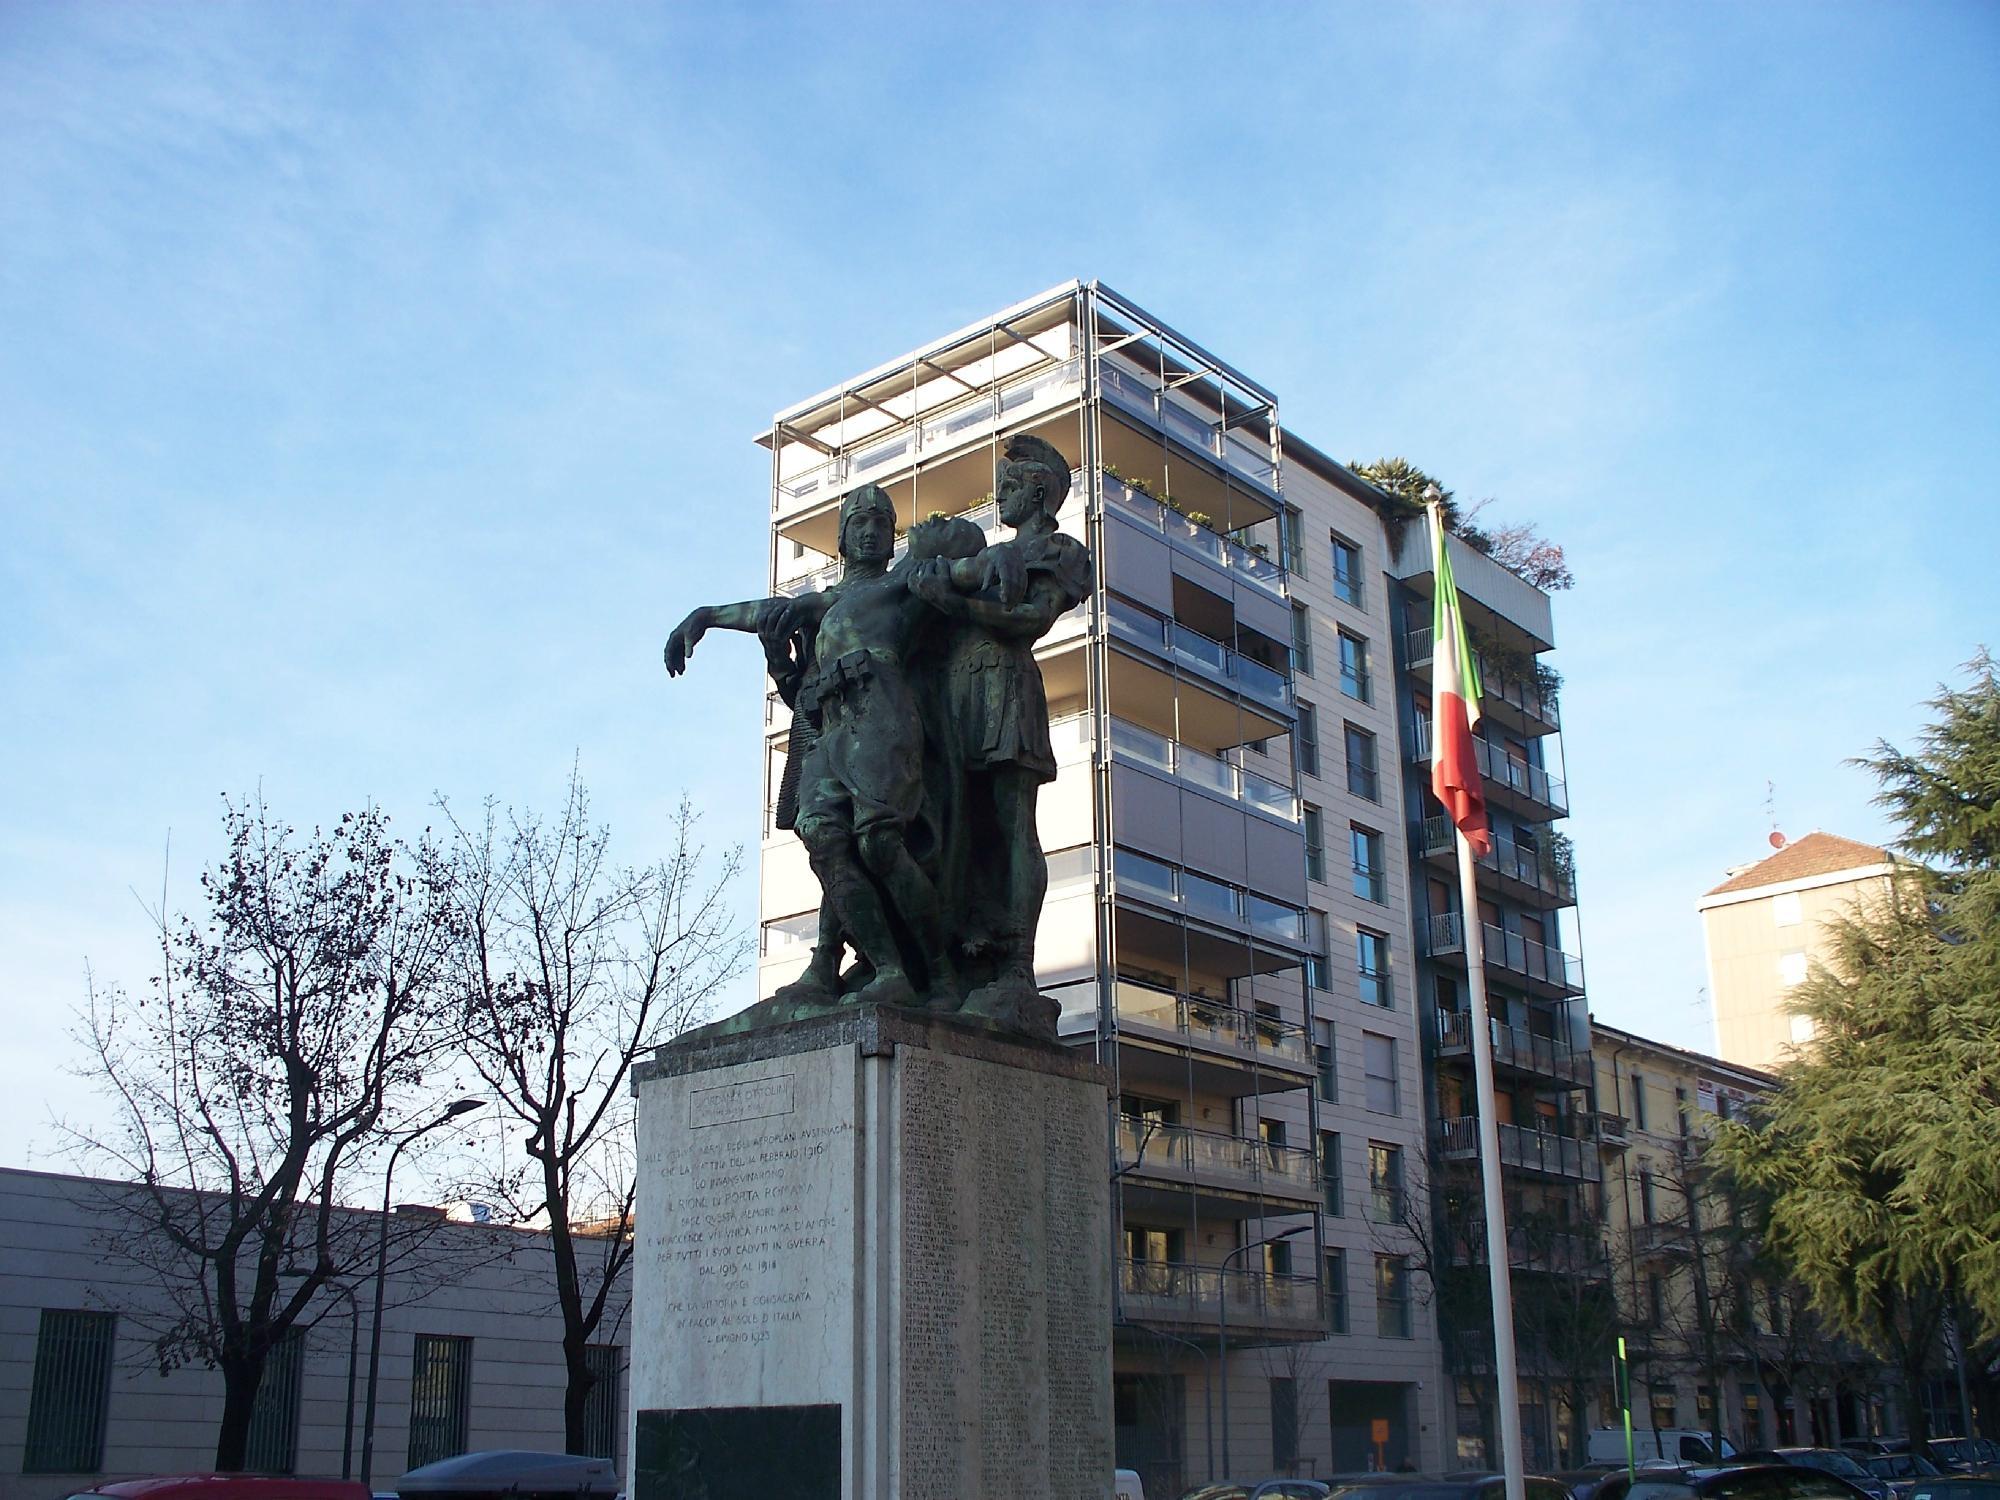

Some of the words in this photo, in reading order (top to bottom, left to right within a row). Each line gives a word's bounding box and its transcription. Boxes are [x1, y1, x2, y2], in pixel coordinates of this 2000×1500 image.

[759, 1147, 798, 1163] FEBBRAIO
[804, 1141, 822, 1157] 1916
[725, 1189, 760, 1204] PORTA
